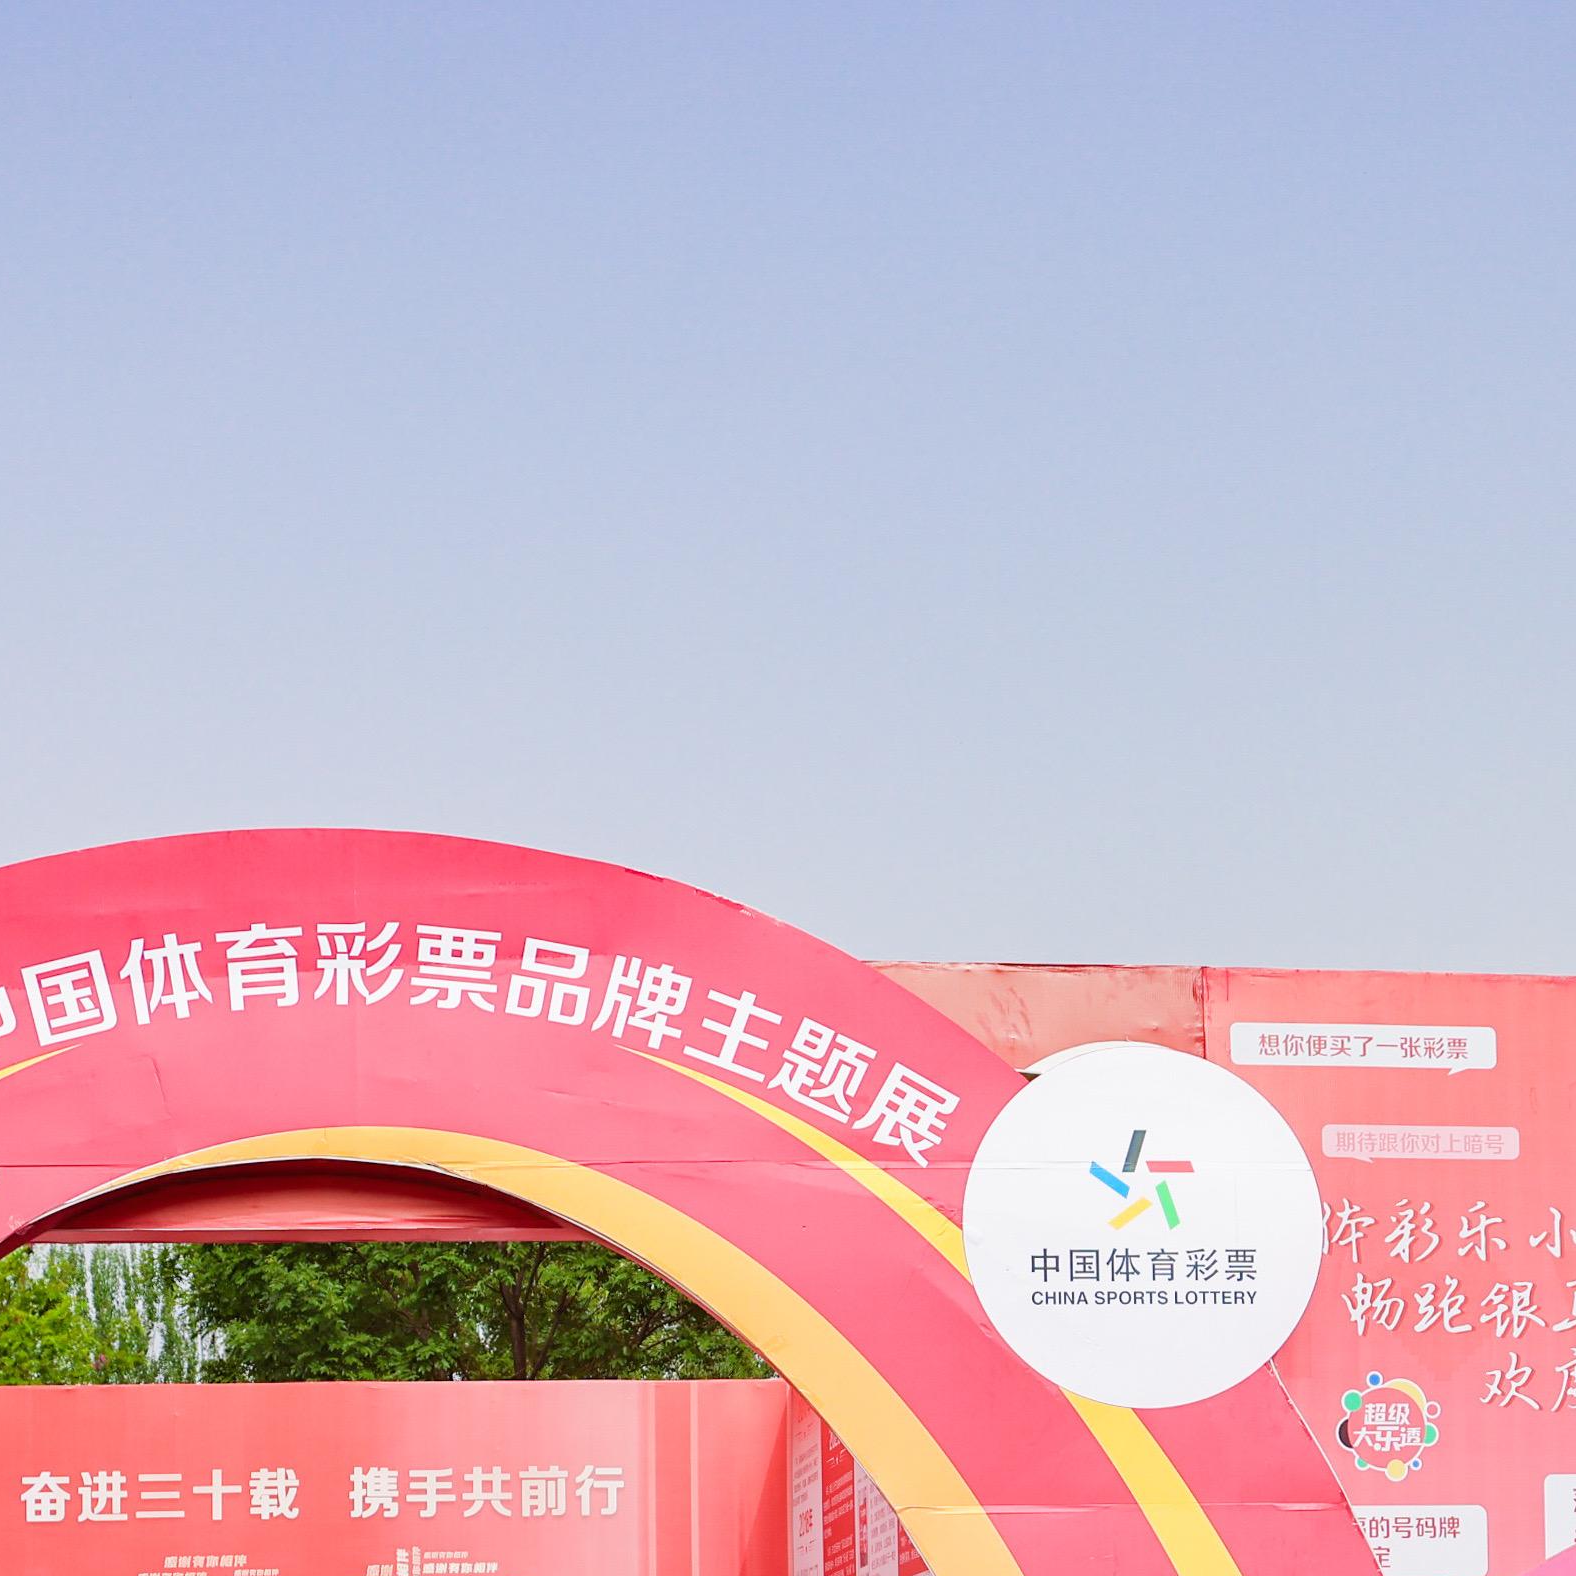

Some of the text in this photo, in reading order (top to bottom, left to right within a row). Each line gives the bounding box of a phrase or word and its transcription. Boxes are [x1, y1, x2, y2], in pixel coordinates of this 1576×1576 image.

[1257, 1032, 1469, 1060] 想你便买了一张彩票
[1335, 1130, 1505, 1156] 期待跟你对上暗号
[1030, 1248, 1257, 1283] 中国体育彩票
[1031, 1291, 1257, 1305] CHINA SPORTS LOTTERY
[1363, 1402, 1411, 1426] 超级
[1352, 1425, 1423, 1452] 大乐透
[21, 1464, 626, 1523] 奋进三十载 携手共前行
[164, 1554, 247, 1568] 感谢有你相伴
[366, 1564, 393, 1576] 感谢
[422, 1562, 498, 1574] 感谢有你相伴
